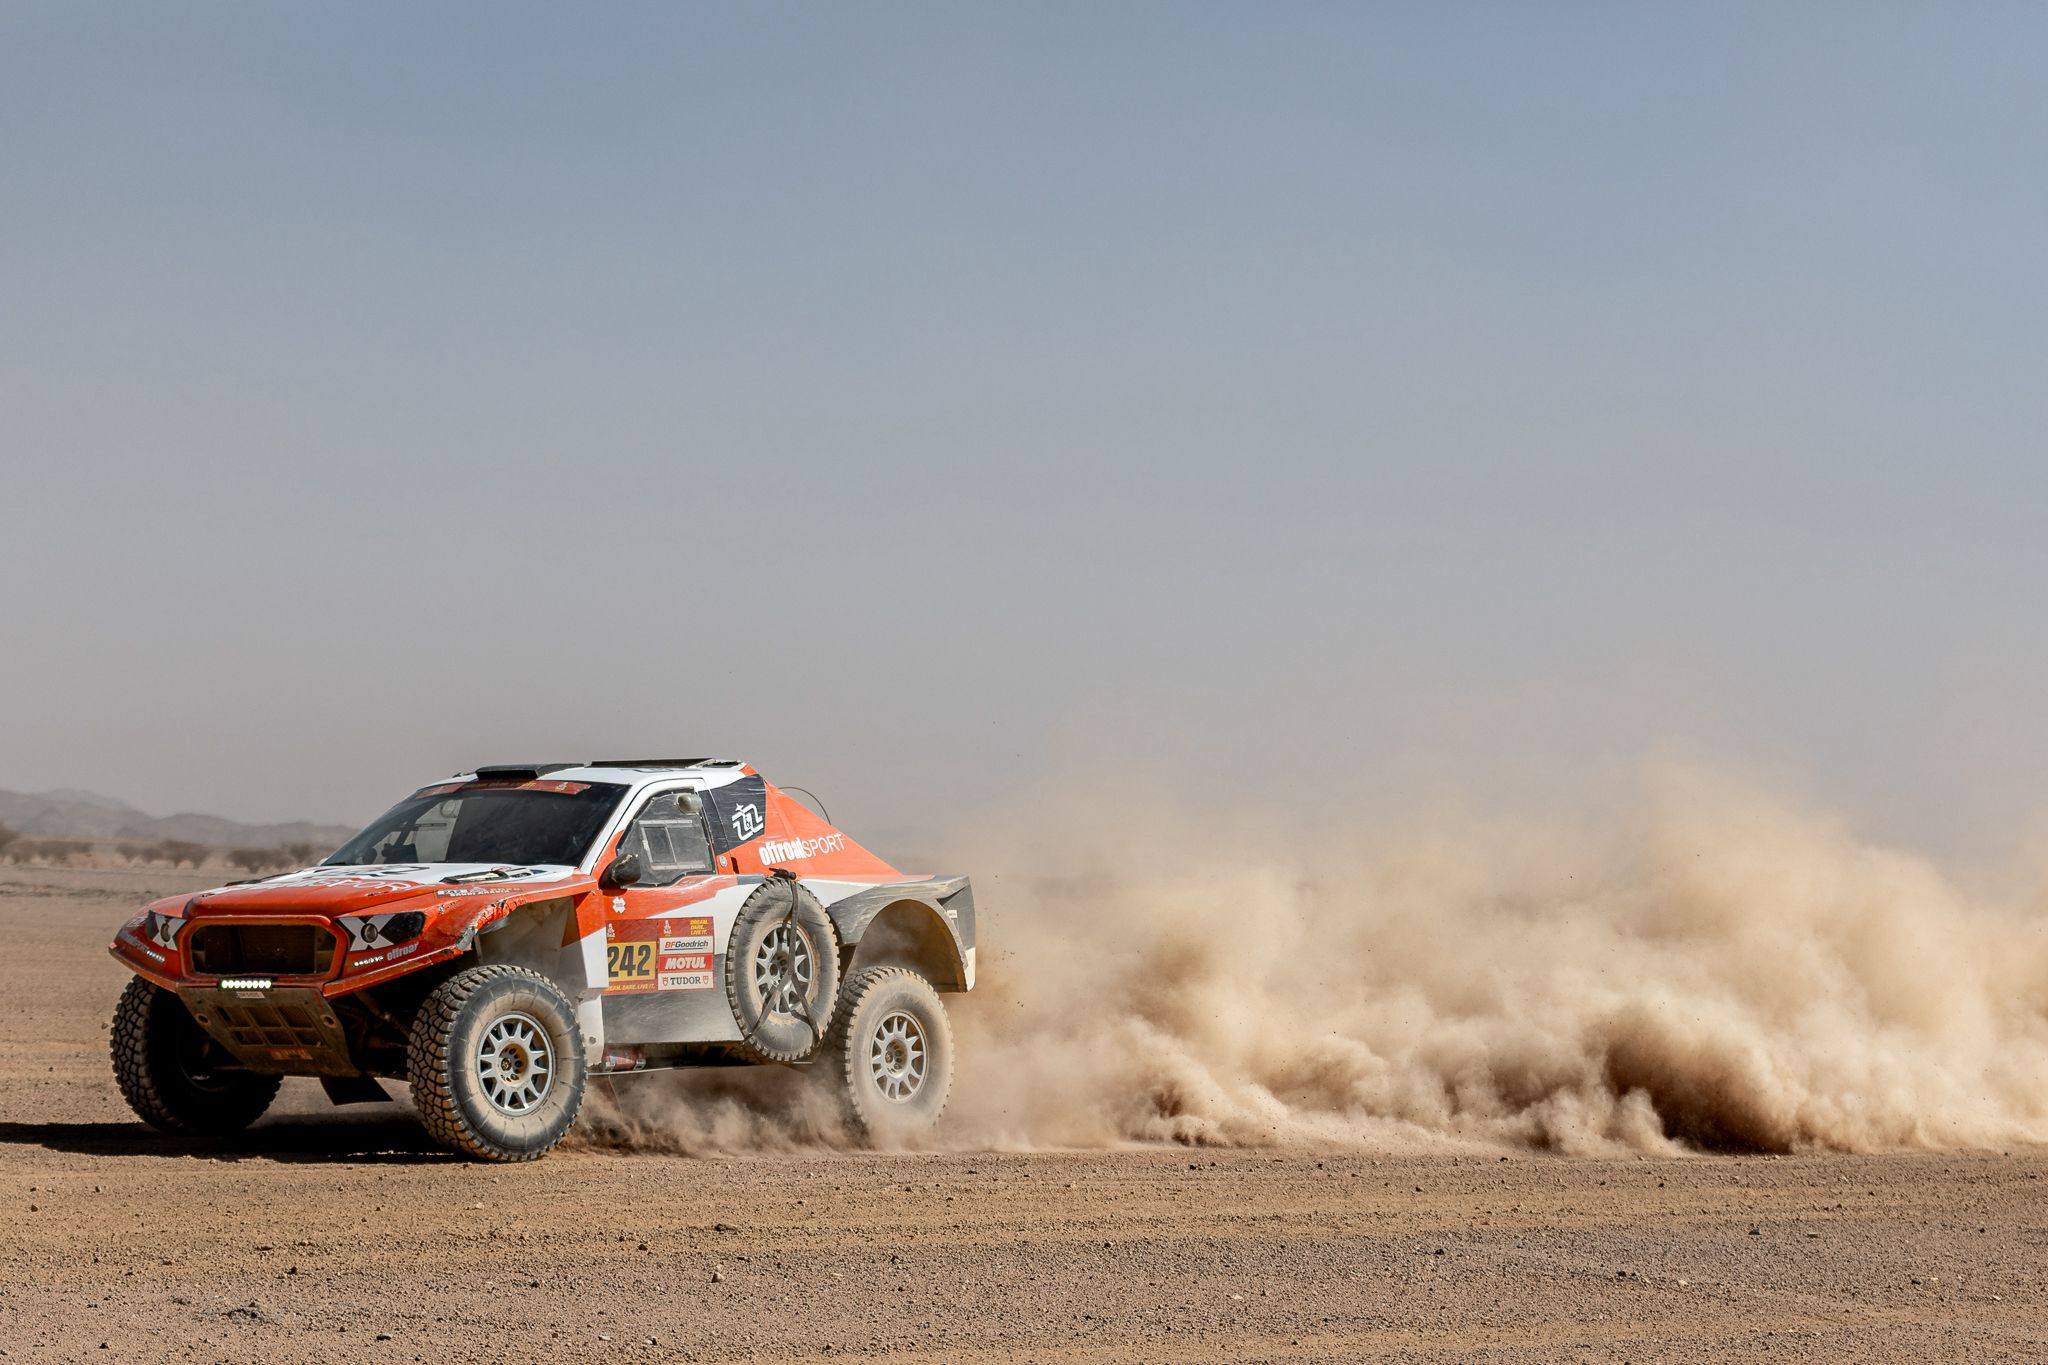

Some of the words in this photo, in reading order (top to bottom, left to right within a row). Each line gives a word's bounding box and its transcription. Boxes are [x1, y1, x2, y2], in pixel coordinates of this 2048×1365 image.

[664, 940, 709, 950] BFGoodrich
[607, 945, 652, 978] 242
[665, 957, 706, 970] MOTUL
[670, 976, 701, 986] TUDOR
